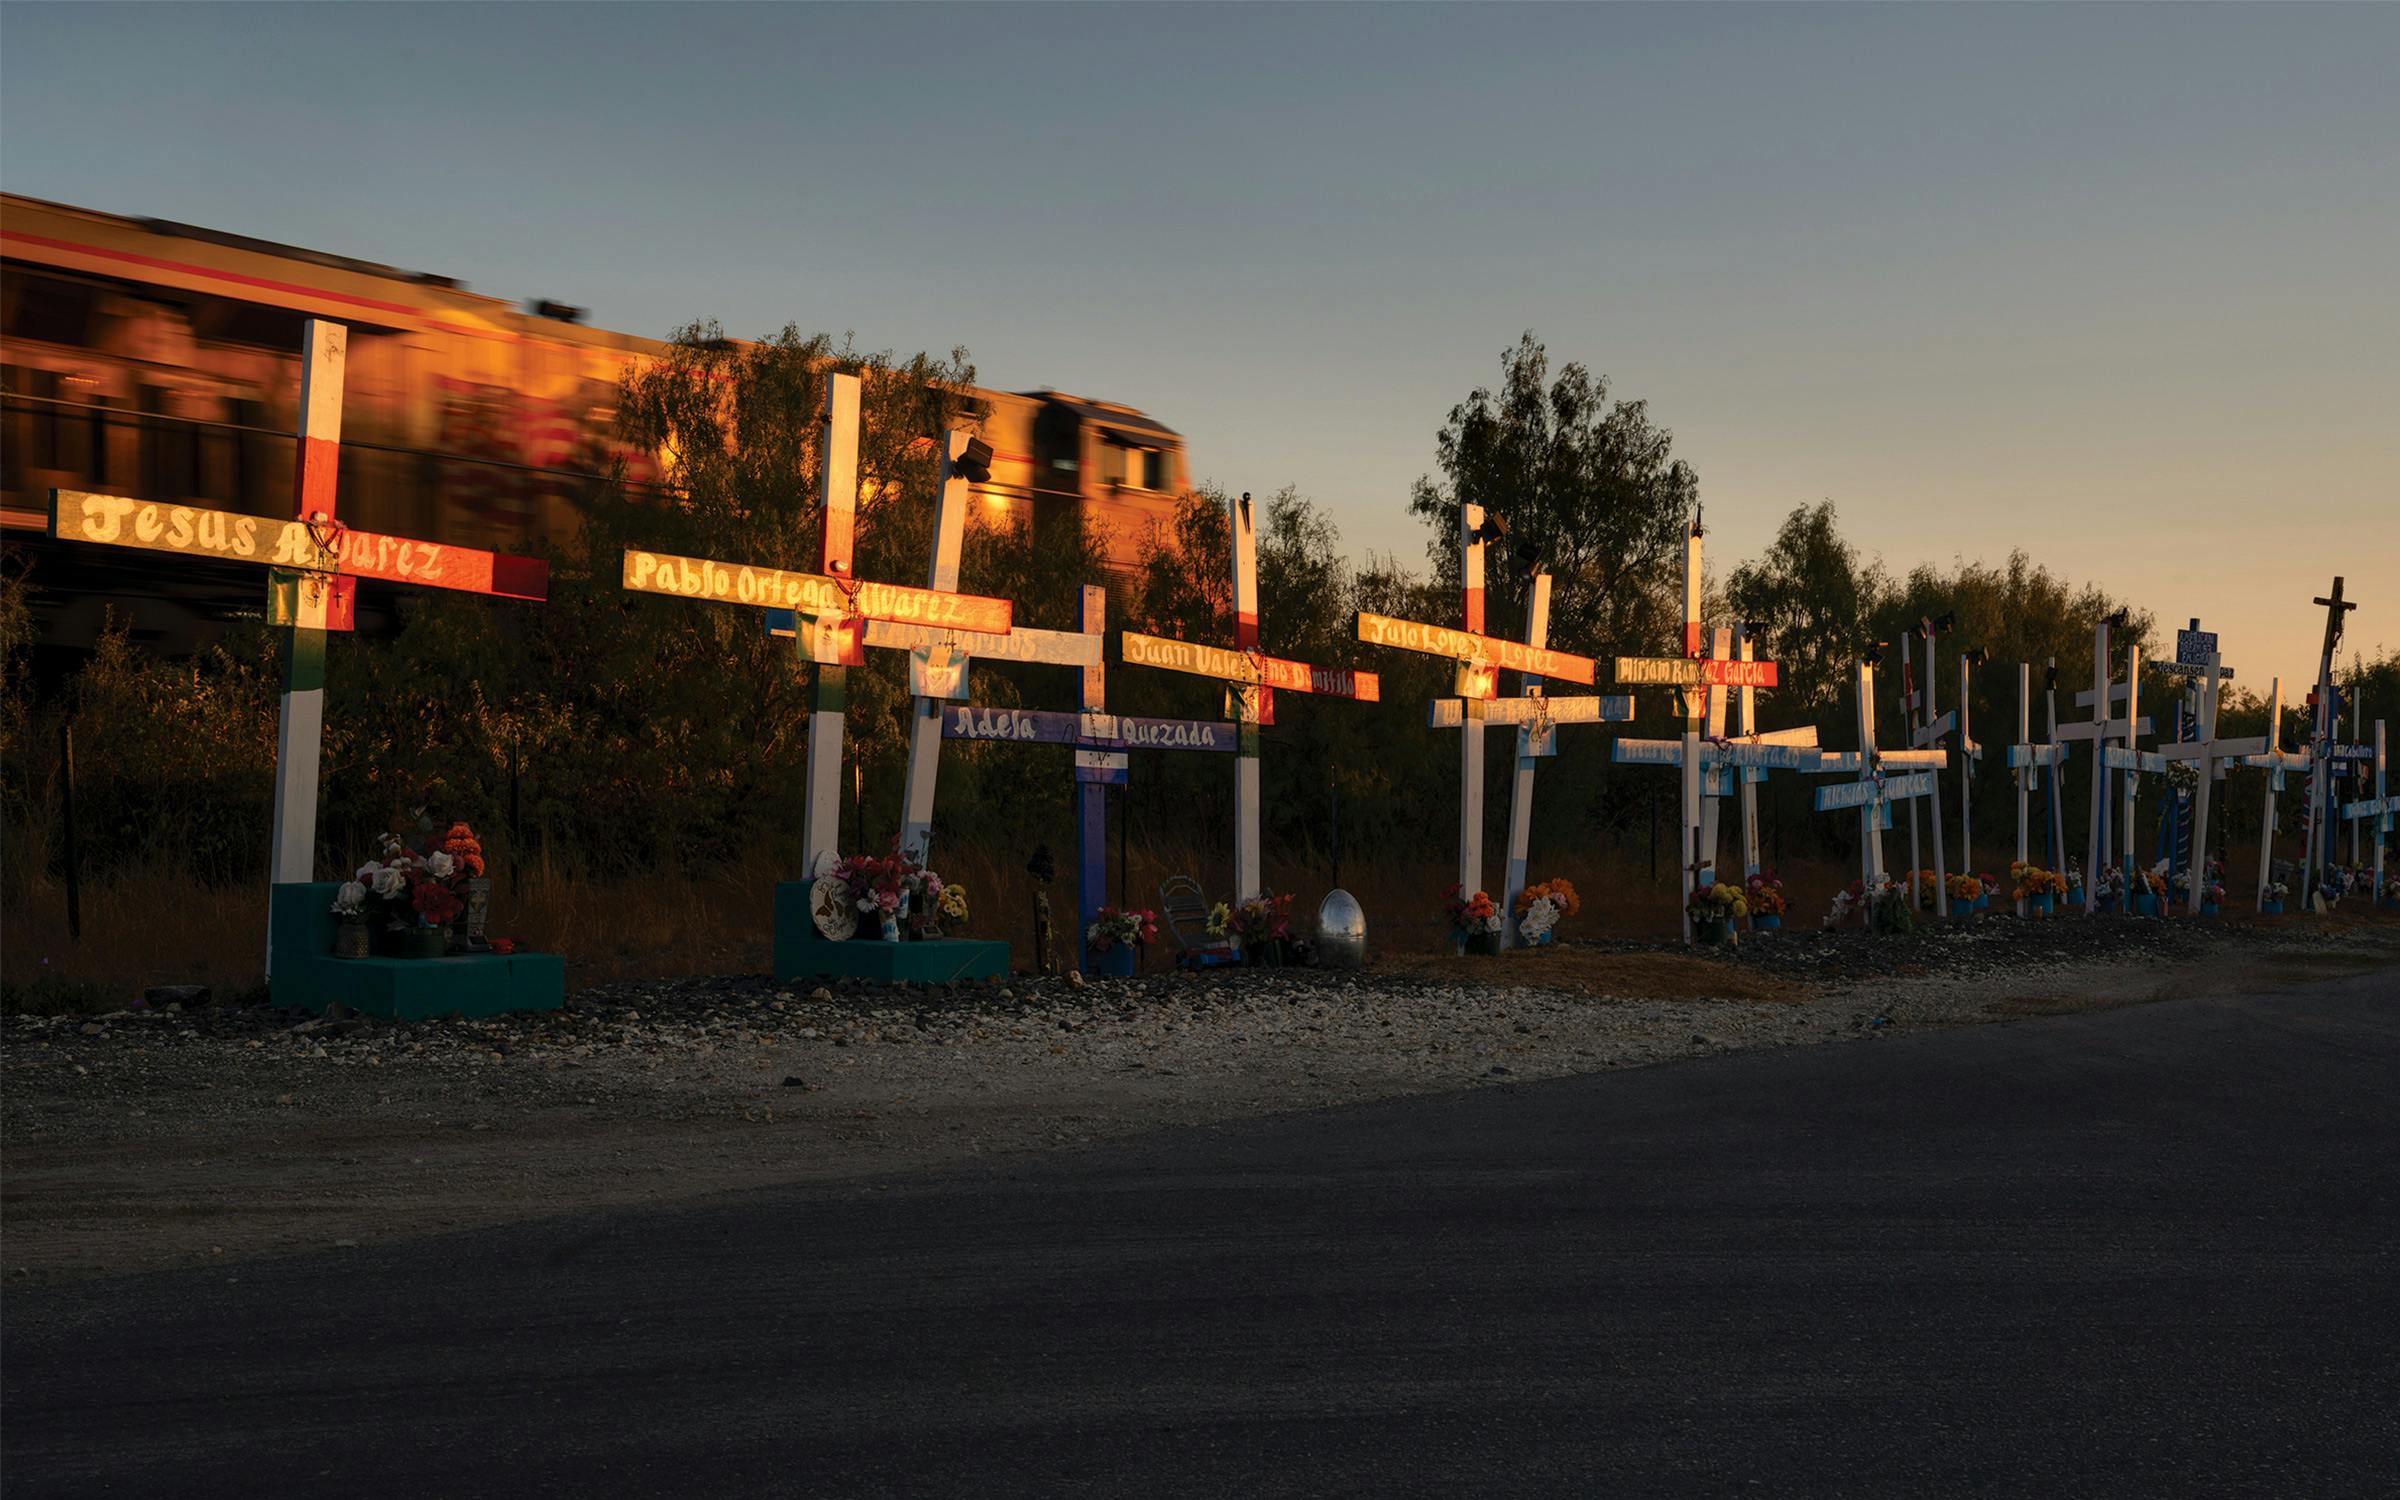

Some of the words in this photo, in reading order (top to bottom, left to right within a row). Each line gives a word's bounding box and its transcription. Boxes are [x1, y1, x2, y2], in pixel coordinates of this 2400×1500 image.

[82, 494, 256, 556] Jesus
[629, 551, 730, 598] Pablo
[1131, 632, 1190, 666] Juan
[1498, 640, 1560, 673] Lopez
[1619, 656, 1670, 683] Miriam
[1724, 661, 1765, 686] Garcia
[954, 707, 1037, 740] Adela
[1122, 719, 1217, 748] Quezada
